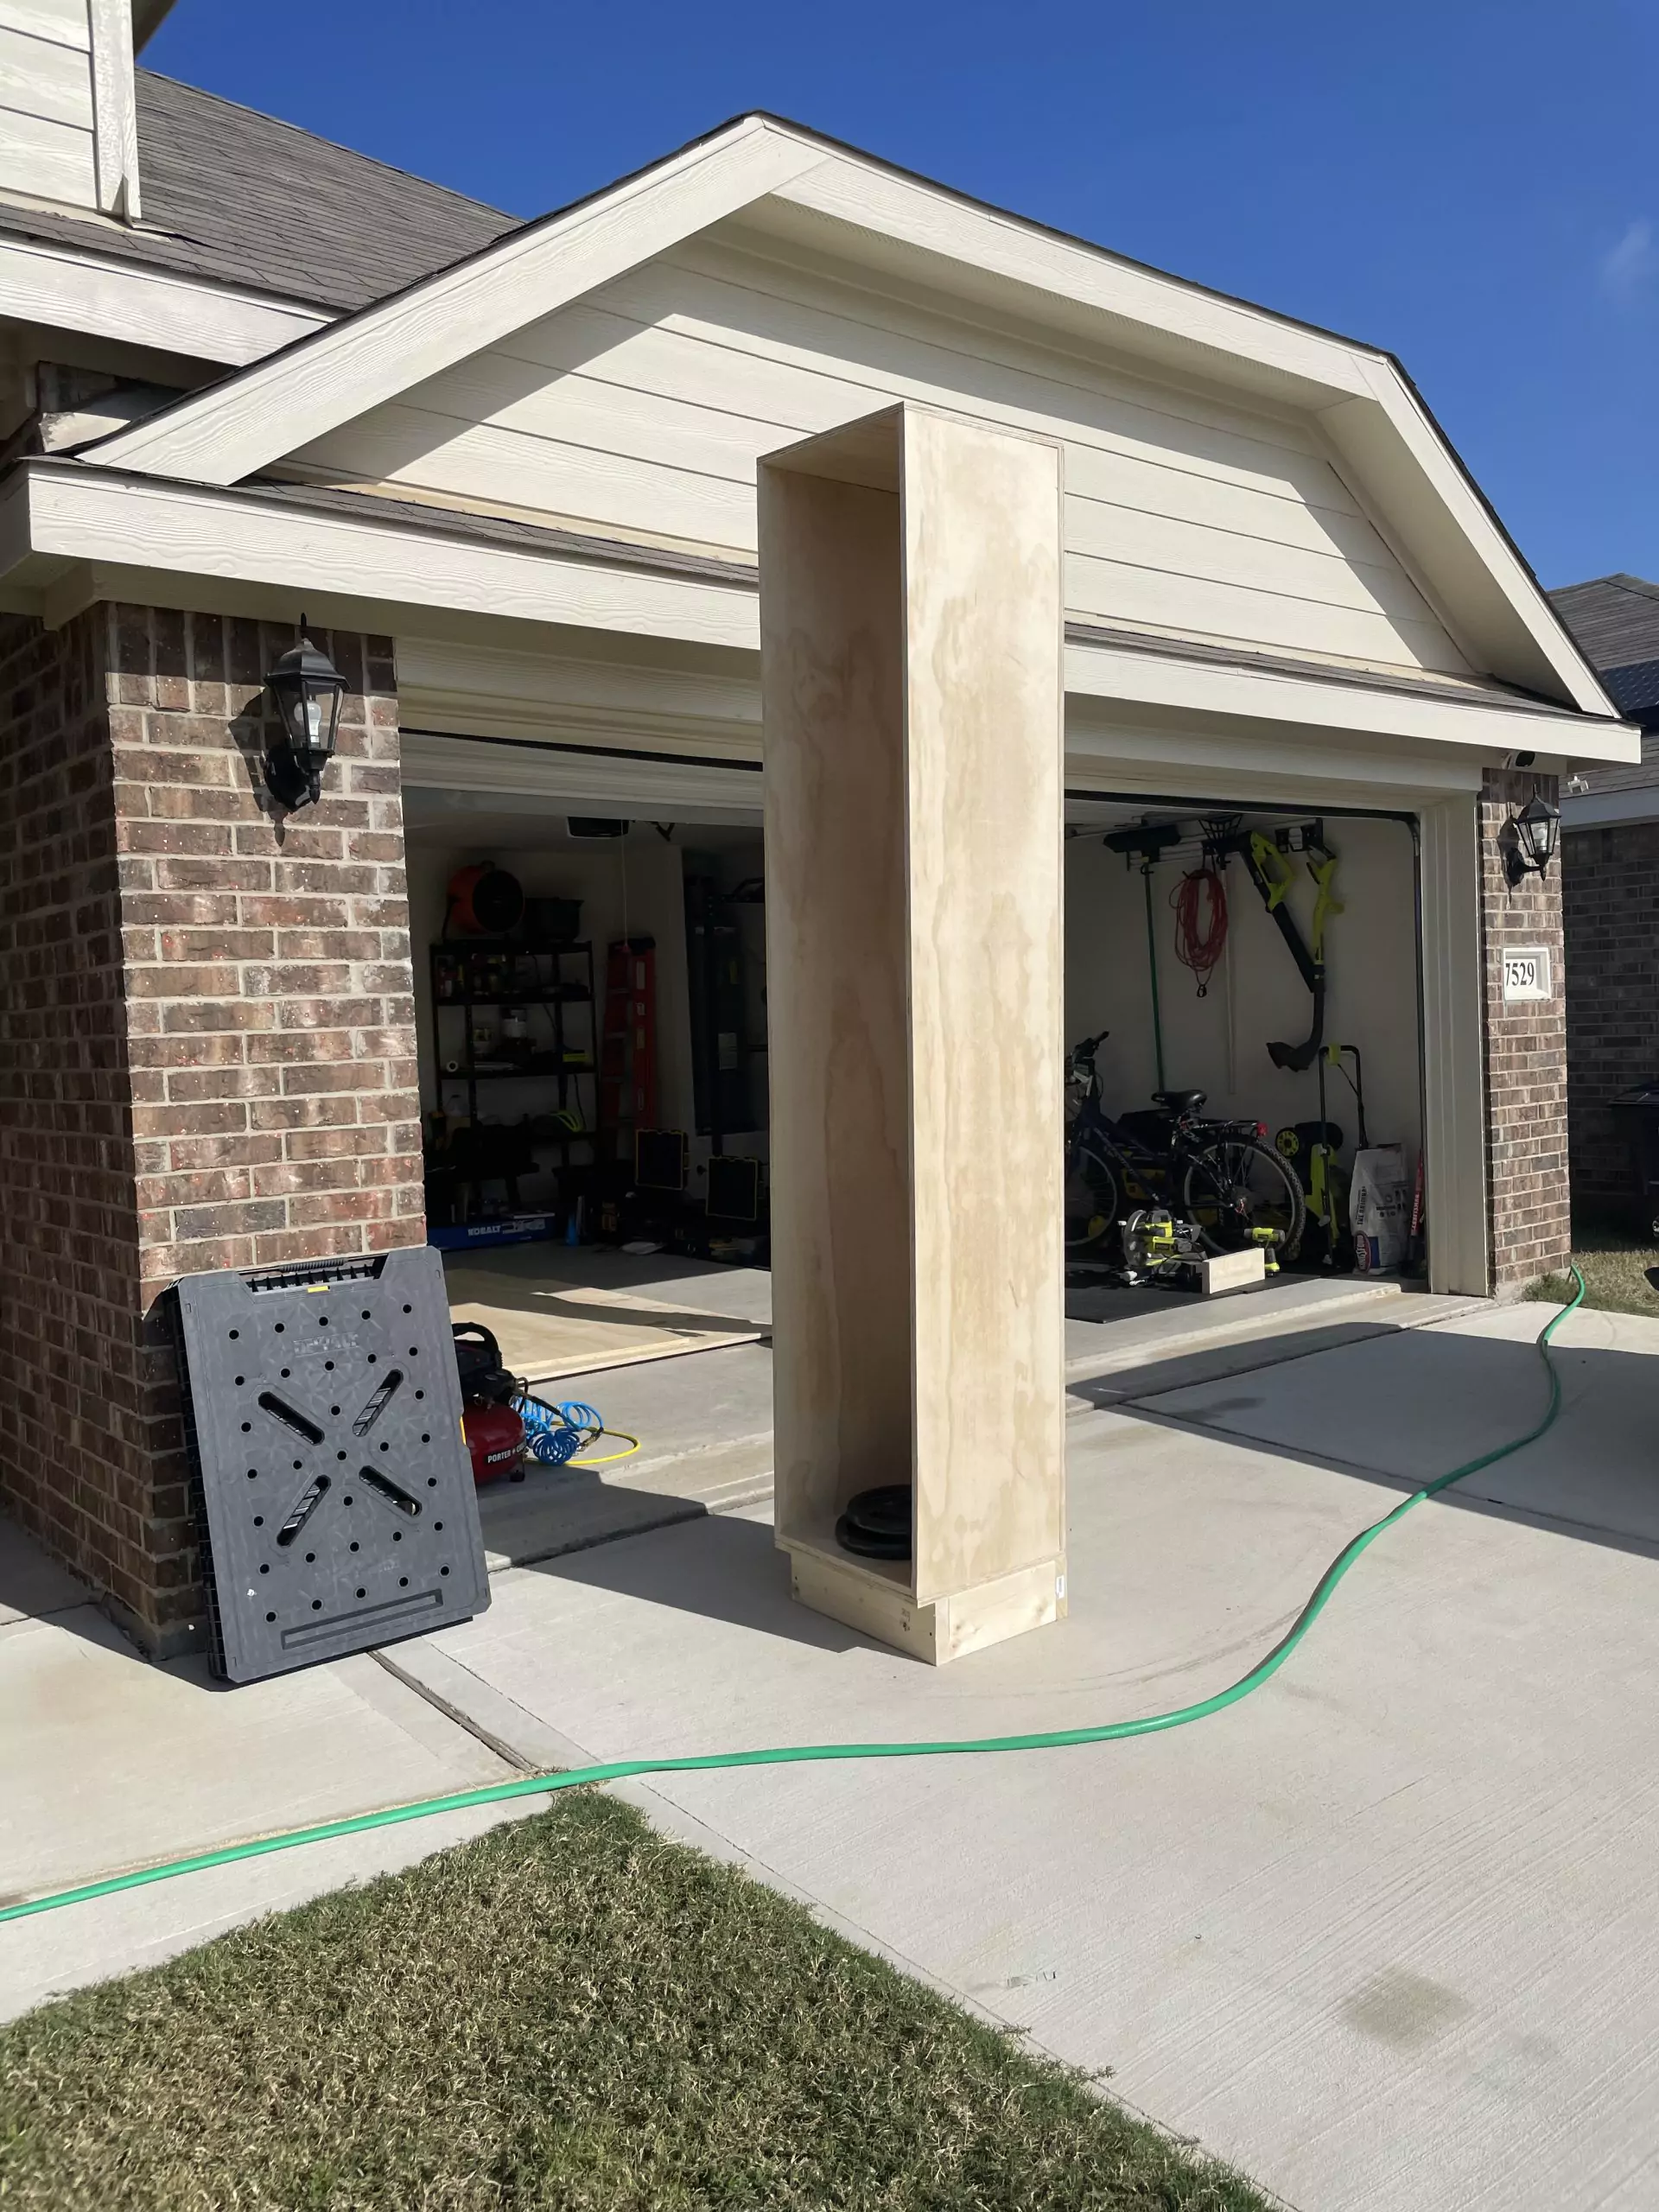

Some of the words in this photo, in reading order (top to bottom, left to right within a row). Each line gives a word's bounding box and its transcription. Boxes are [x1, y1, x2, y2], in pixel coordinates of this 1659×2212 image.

[1505, 962, 1535, 986] 7529
[467, 1225, 501, 1236] KOBALT
[487, 1450, 512, 1463] PORTER
